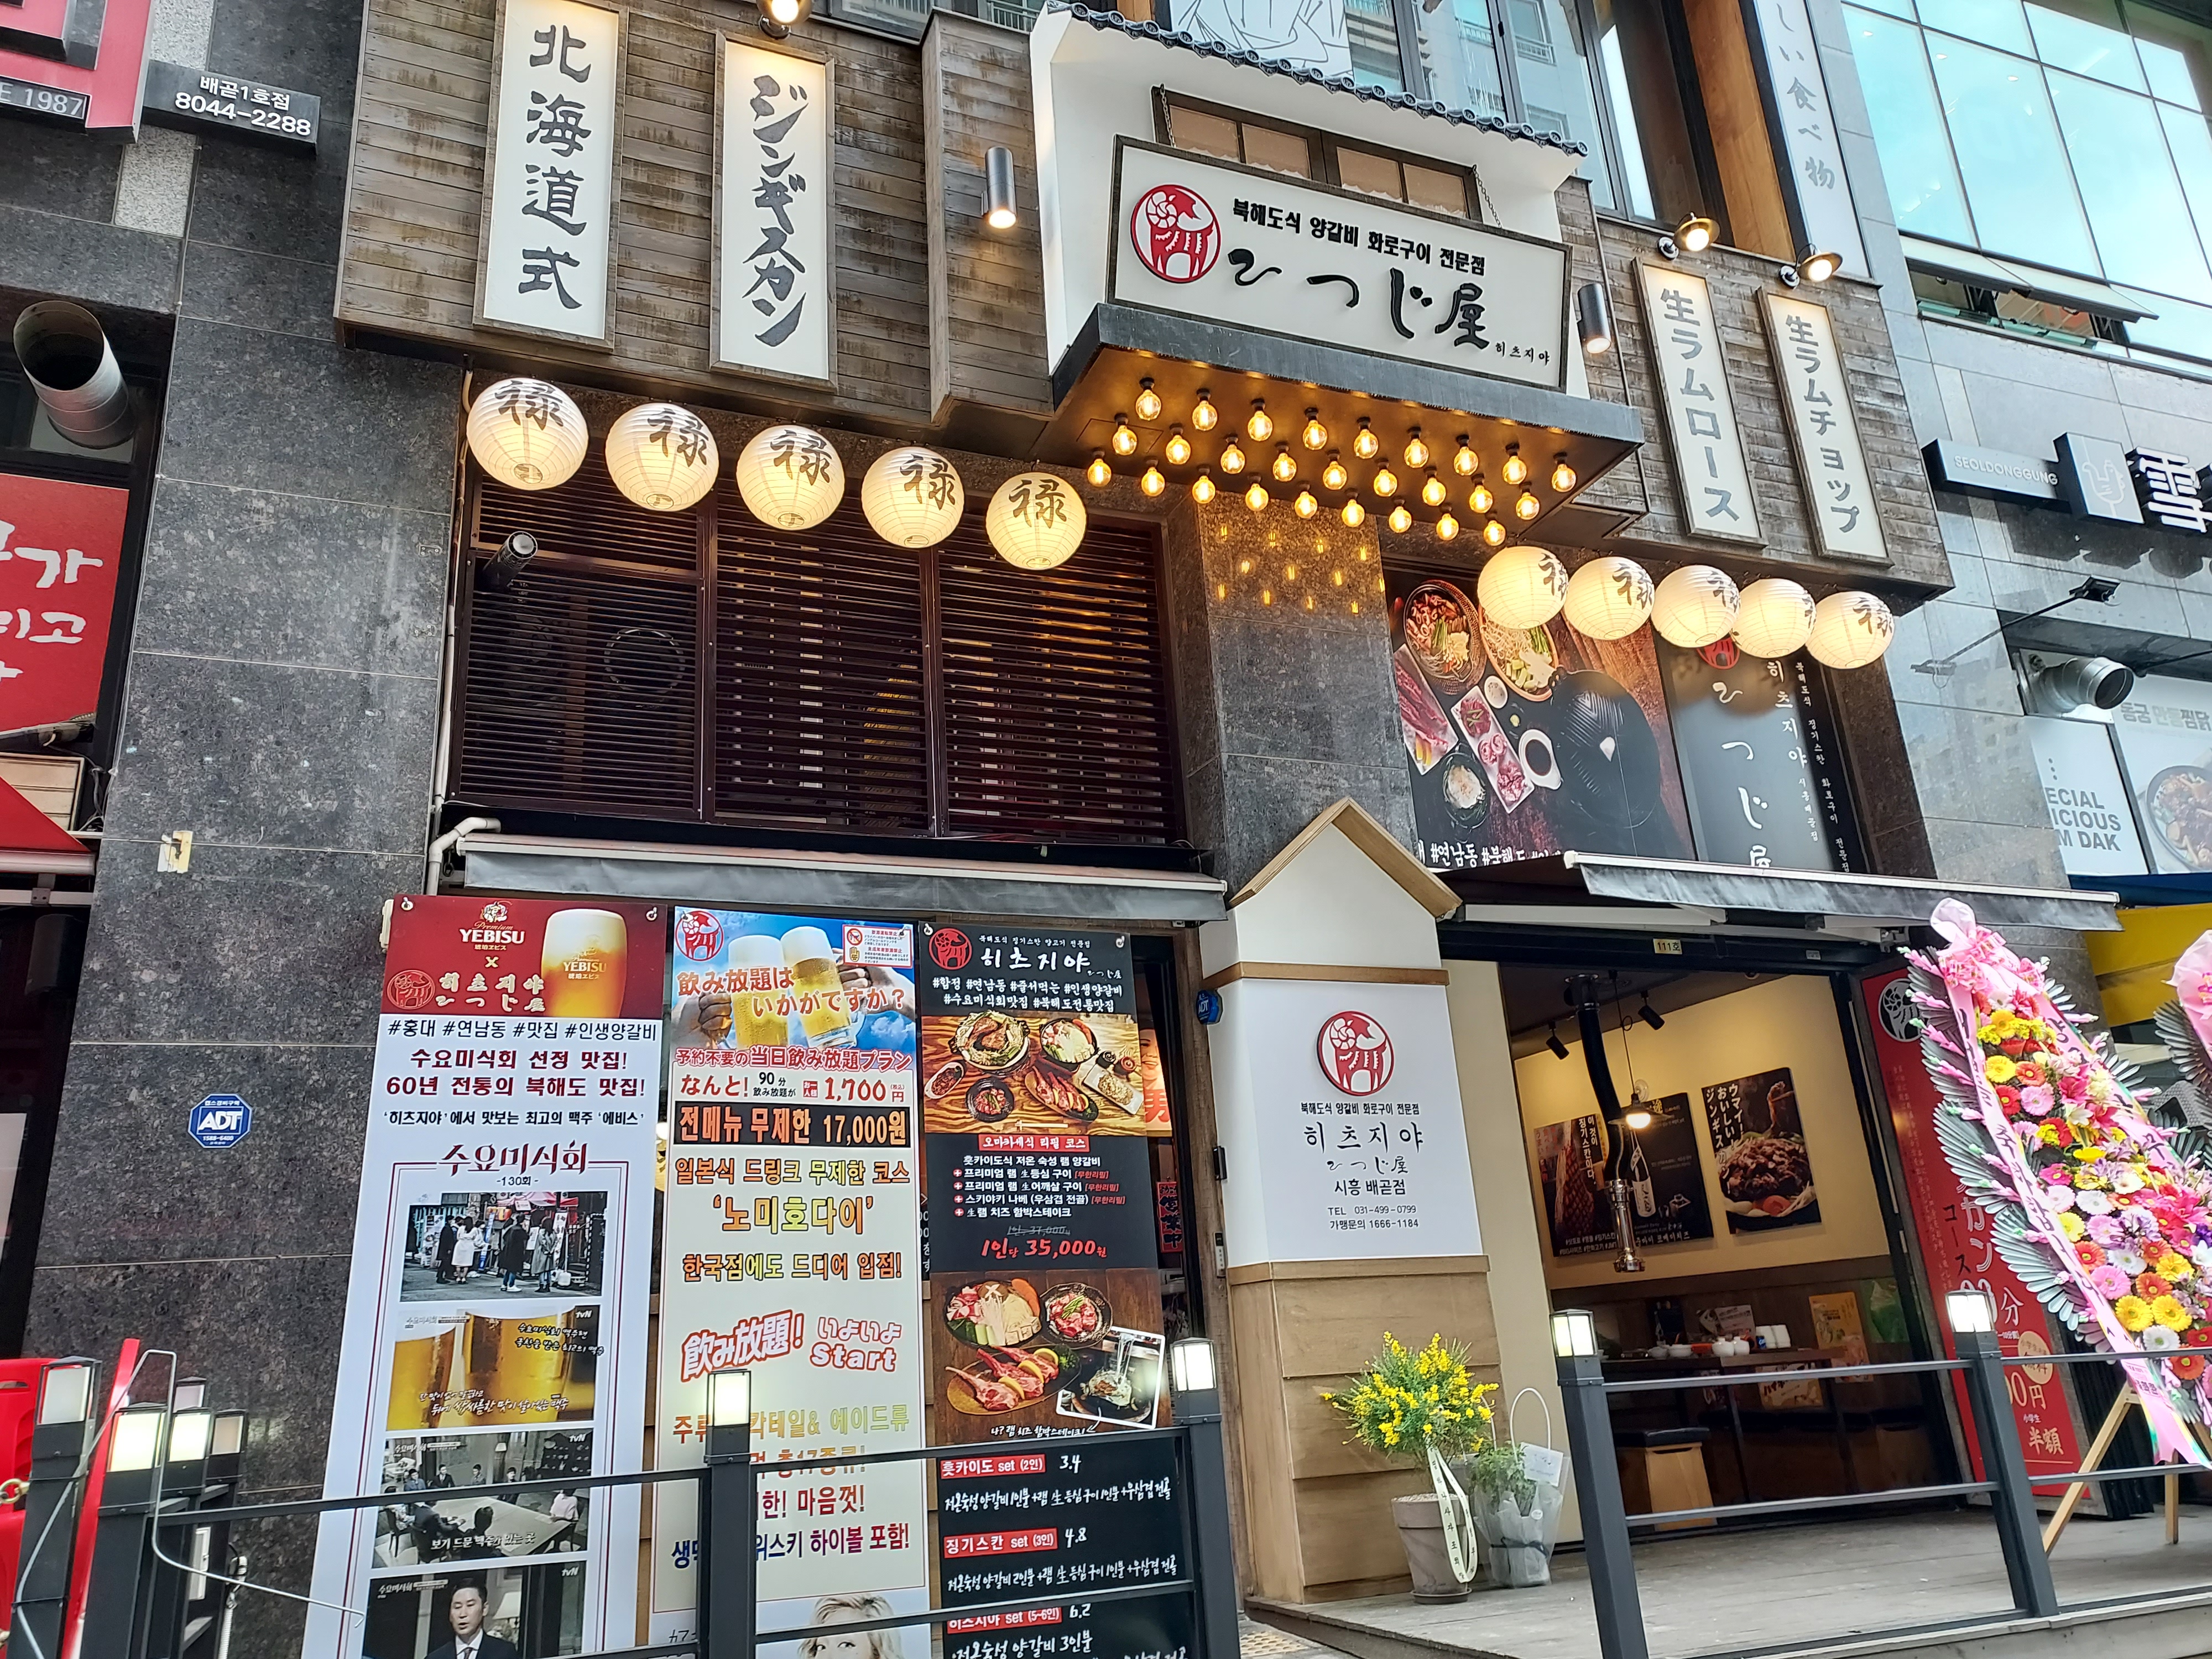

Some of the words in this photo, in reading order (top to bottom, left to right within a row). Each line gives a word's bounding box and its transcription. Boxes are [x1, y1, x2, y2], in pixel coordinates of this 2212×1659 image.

[25, 88, 84, 115] 1987
[200, 76, 290, 111] 배곧1호점
[175, 92, 311, 136] 8044-2288
[518, 24, 592, 309] 北海道式
[742, 75, 808, 347] ジンギスカン
[1233, 199, 1301, 234] 북해도식
[1310, 217, 1360, 248] 양갈비
[1368, 231, 1431, 265] 화로구이
[1439, 248, 1485, 276] 전문점
[1227, 248, 1490, 351] ひつじ屋
[1496, 341, 1550, 366] 히츠지야
[1660, 288, 1740, 521] 生ラムロース
[1785, 314, 1860, 533] 生ラムチョップ
[1954, 455, 2058, 486] SEOLDONGGUNG
[1766, 660, 1807, 769] 히츠지야
[1795, 661, 1812, 707] 북해도식
[1821, 777, 1838, 824] 화로구이
[2078, 831, 2121, 851] DAK
[1430, 841, 1478, 868] #연남동
[460, 929, 525, 944] YEBISU
[979, 935, 1008, 943] 북해도식
[1070, 940, 1091, 948] 전문점
[1657, 942, 1681, 951] 111호
[563, 961, 607, 972] YEBISU
[980, 948, 1091, 972] 히츠지야
[439, 972, 545, 994] 히츠지야
[677, 967, 795, 995] 飲み放題は
[932, 977, 961, 990] #합정
[966, 979, 1006, 990] #연남동
[1010, 981, 1061, 994] #줄서먹는
[1064, 984, 1123, 997] #인생양갈비
[943, 994, 1028, 1009] #수요미식회맛집
[1033, 997, 1114, 1012] #북해도전통맛집
[387, 1020, 435, 1037] #홍대
[442, 1021, 507, 1039] #연남동
[512, 1022, 558, 1039] #맛집
[565, 1024, 656, 1041] #인생양갈비
[410, 1049, 517, 1069] 수요미식회
[529, 1050, 568, 1069] 선정
[581, 1051, 627, 1070] 맛집!
[675, 1046, 912, 1072] 予約不要の当日飲み放題プラン
[387, 1077, 439, 1095] 60년
[451, 1077, 514, 1095] 전통의
[526, 1077, 587, 1096] 북해도
[599, 1078, 645, 1096] 맛집!
[753, 1087, 796, 1098] 飲み放題が
[825, 1078, 886, 1102] 1,700
[482, 1112, 519, 1125] 맛보는
[525, 1112, 562, 1125] 최고의
[568, 1112, 593, 1125] 맥주
[1301, 1102, 1333, 1115] 북해도식
[1335, 1102, 1359, 1115] 양갈비
[1363, 1103, 1393, 1115] 화로구이
[1397, 1103, 1420, 1115] 전문점
[198, 1111, 242, 1130] ADT
[680, 1107, 742, 1144] 전메뉴
[751, 1108, 811, 1144] 무제한
[823, 1110, 906, 1145] 17,000원
[982, 1136, 1034, 1149] 오마카세식
[1040, 1137, 1060, 1149] 리필
[1066, 1139, 1086, 1149] 코스
[1304, 1121, 1423, 1154] 히츠지야
[437, 1140, 588, 1177] 수요미식회
[1016, 1156, 1035, 1166] 저온
[1038, 1156, 1057, 1166] 숙성
[1060, 1156, 1070, 1166] 램
[1072, 1156, 1100, 1167] 양갈비
[1327, 1156, 1408, 1175] ひつじ屋
[675, 1158, 735, 1185] 일본식
[743, 1159, 801, 1185] 드링크
[810, 1160, 865, 1186] 무제한
[872, 1160, 910, 1184] 코스
[964, 1169, 1004, 1178] 프리미엄
[1007, 1169, 1017, 1178] 램
[1052, 1170, 1072, 1178] 구이
[964, 1181, 1004, 1192] 프리미엄
[1008, 1182, 1018, 1192] 램
[1062, 1182, 1082, 1192] 구이
[1334, 1179, 1361, 1196] 시흥
[1365, 1180, 1406, 1196] 배곧점
[965, 1194, 1005, 1204] 스키야키
[1008, 1194, 1027, 1204] 나베
[1066, 1194, 1089, 1206] 전골)
[1328, 1207, 1347, 1215] TEL
[1354, 1206, 1417, 1214] 031-499-0799
[990, 1207, 1010, 1217] 치즈
[1013, 1207, 1072, 1218] 함박스테이크
[1329, 1220, 1365, 1230] 가맹문의
[1369, 1220, 1419, 1228] 1666-1184
[981, 1237, 1019, 1259] 1인당
[1024, 1240, 1107, 1259] 35,000원
[1943, 1204, 1971, 1276] コース
[682, 1253, 784, 1282] 한국점에도
[791, 1253, 848, 1280] 드디어
[857, 1251, 902, 1280] 입점!
[518, 1323, 560, 1337] 수요미식회
[817, 1316, 902, 1344] いよいよ
[544, 1340, 559, 1350] 받은
[562, 1343, 586, 1353] 최고의
[588, 1345, 604, 1356] 맥주
[810, 1340, 897, 1373] Start
[831, 1404, 909, 1434] 에이드류
[569, 1433, 586, 1443] tvN
[1018, 1425, 1033, 1437] 치즈
[2028, 1426, 2064, 1455] 半額
[998, 1461, 1015, 1472] set
[1020, 1457, 1043, 1472] (2인)
[1059, 1455, 1082, 1474] 3.4
[797, 1485, 865, 1517] 마음껏!
[431, 1538, 451, 1550] 보기
[453, 1536, 472, 1548] 드문
[503, 1533, 523, 1546] 있는
[524, 1532, 536, 1544] 곳
[810, 1526, 863, 1556] 하이볼
[869, 1522, 910, 1551] 포함!
[946, 1536, 1003, 1554] 징기스칸
[1010, 1535, 1029, 1548] set
[1032, 1533, 1055, 1547] (3인)
[1065, 1527, 1088, 1548] 4.8
[561, 1567, 579, 1577] tvN
[1005, 1611, 1024, 1624] set
[1069, 1603, 1092, 1619] 6.2
[1060, 1629, 1093, 1653] 3인분
